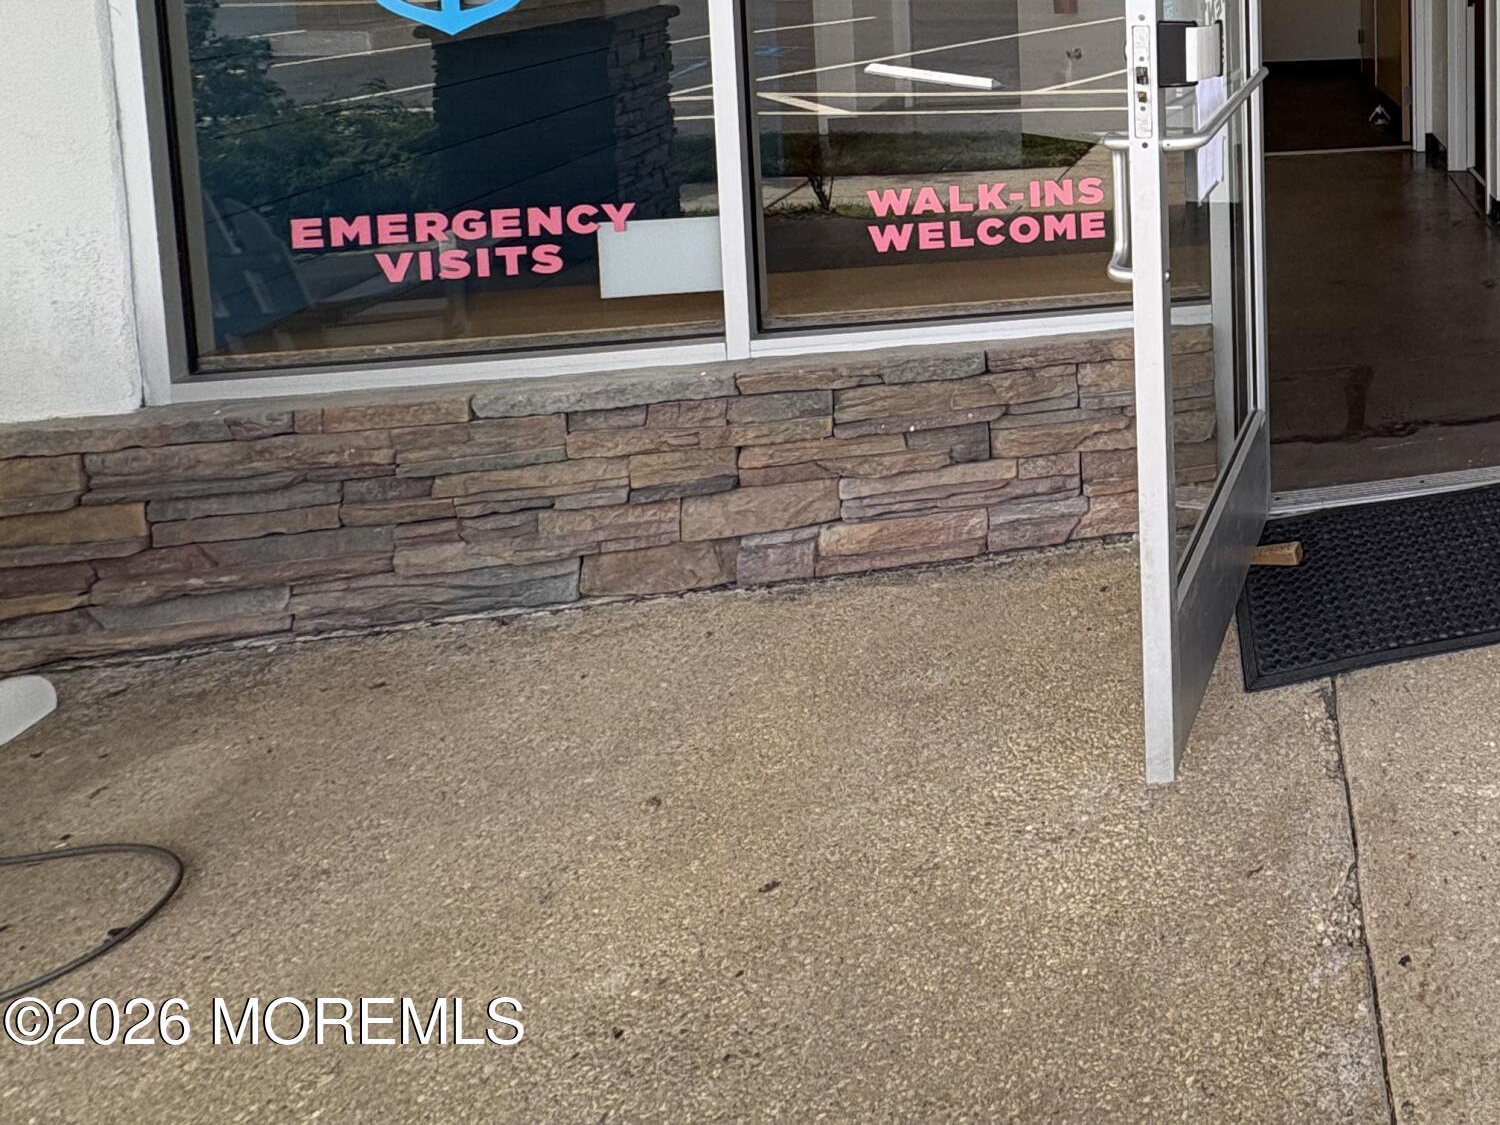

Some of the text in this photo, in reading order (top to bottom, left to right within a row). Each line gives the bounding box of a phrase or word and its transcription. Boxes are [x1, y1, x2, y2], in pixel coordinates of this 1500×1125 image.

[867, 177, 1105, 217] WALK-INS
[290, 202, 635, 249] EMERGENCY
[867, 211, 1106, 253] WELCOME
[375, 244, 564, 283] VISITS
